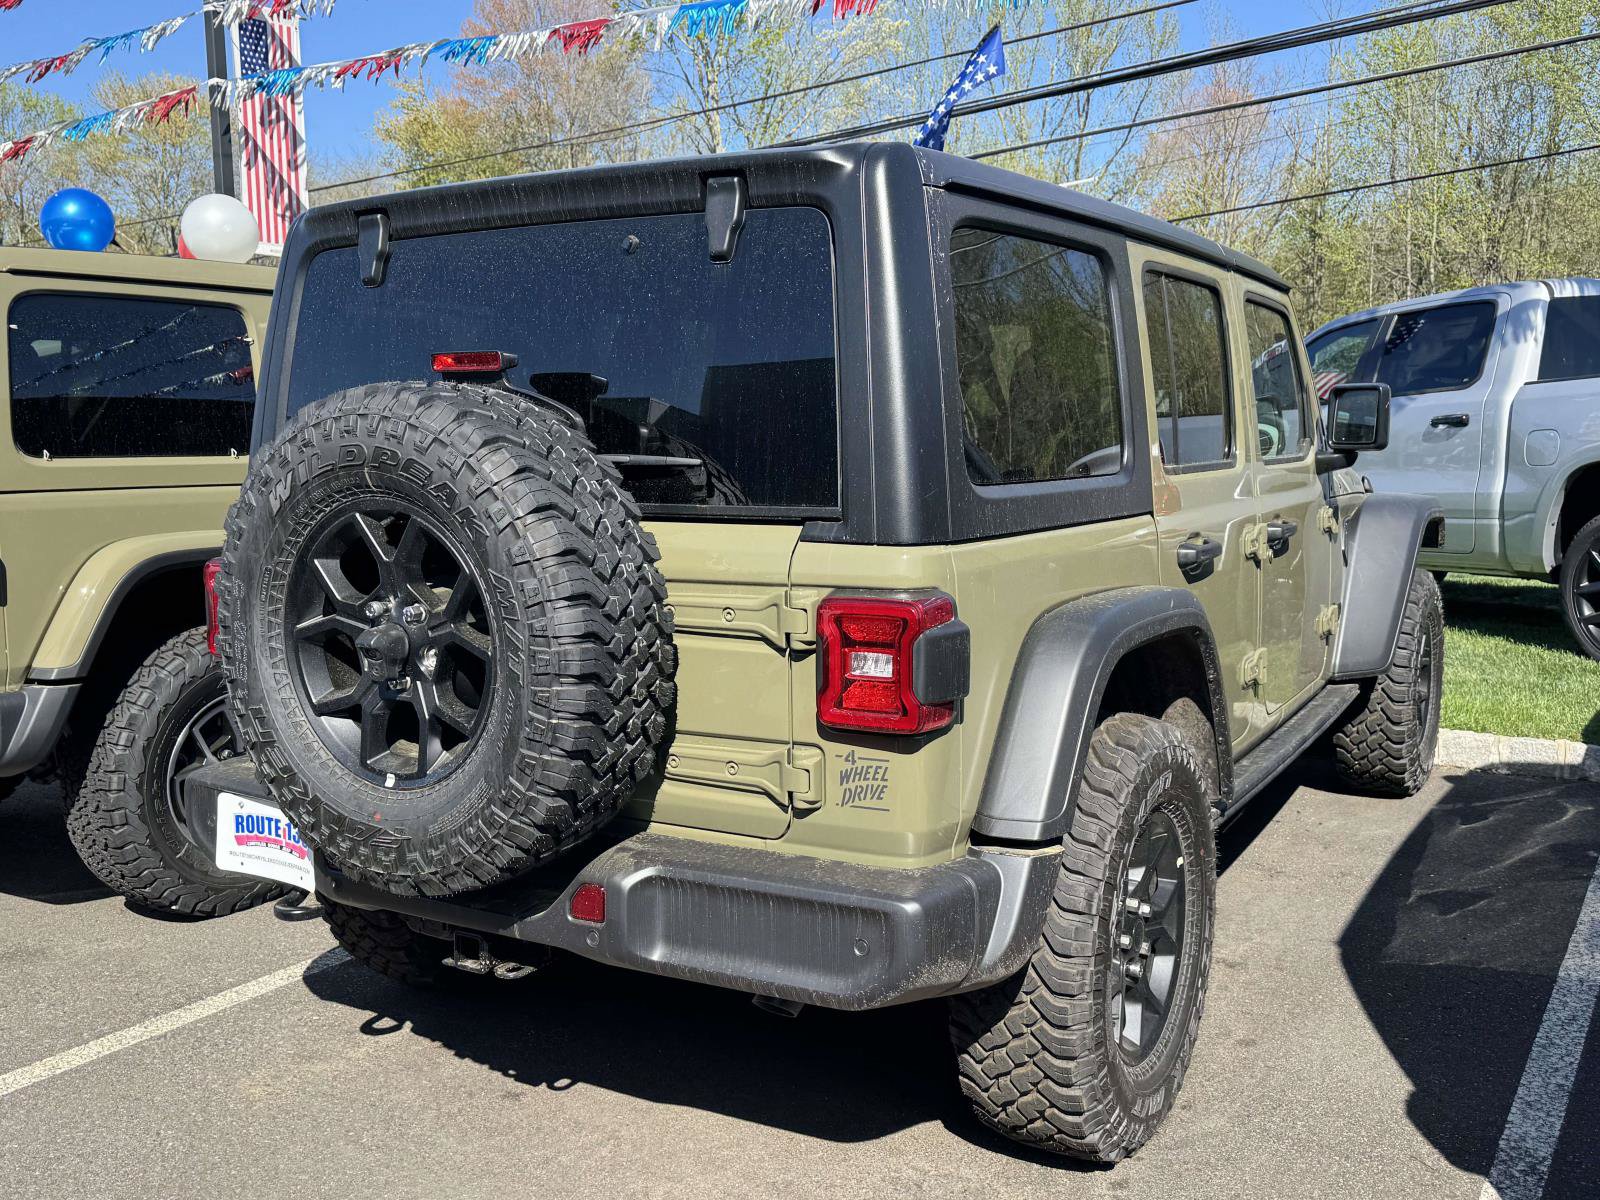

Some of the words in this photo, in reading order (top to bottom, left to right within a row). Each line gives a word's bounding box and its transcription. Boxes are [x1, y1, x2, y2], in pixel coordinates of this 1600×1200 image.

[267, 442, 490, 542] WILDPEAK
[844, 749, 857, 766] 4
[840, 765, 889, 787] WHEEL
[841, 784, 888, 808] DRIVE
[234, 814, 282, 838] ROUTE
